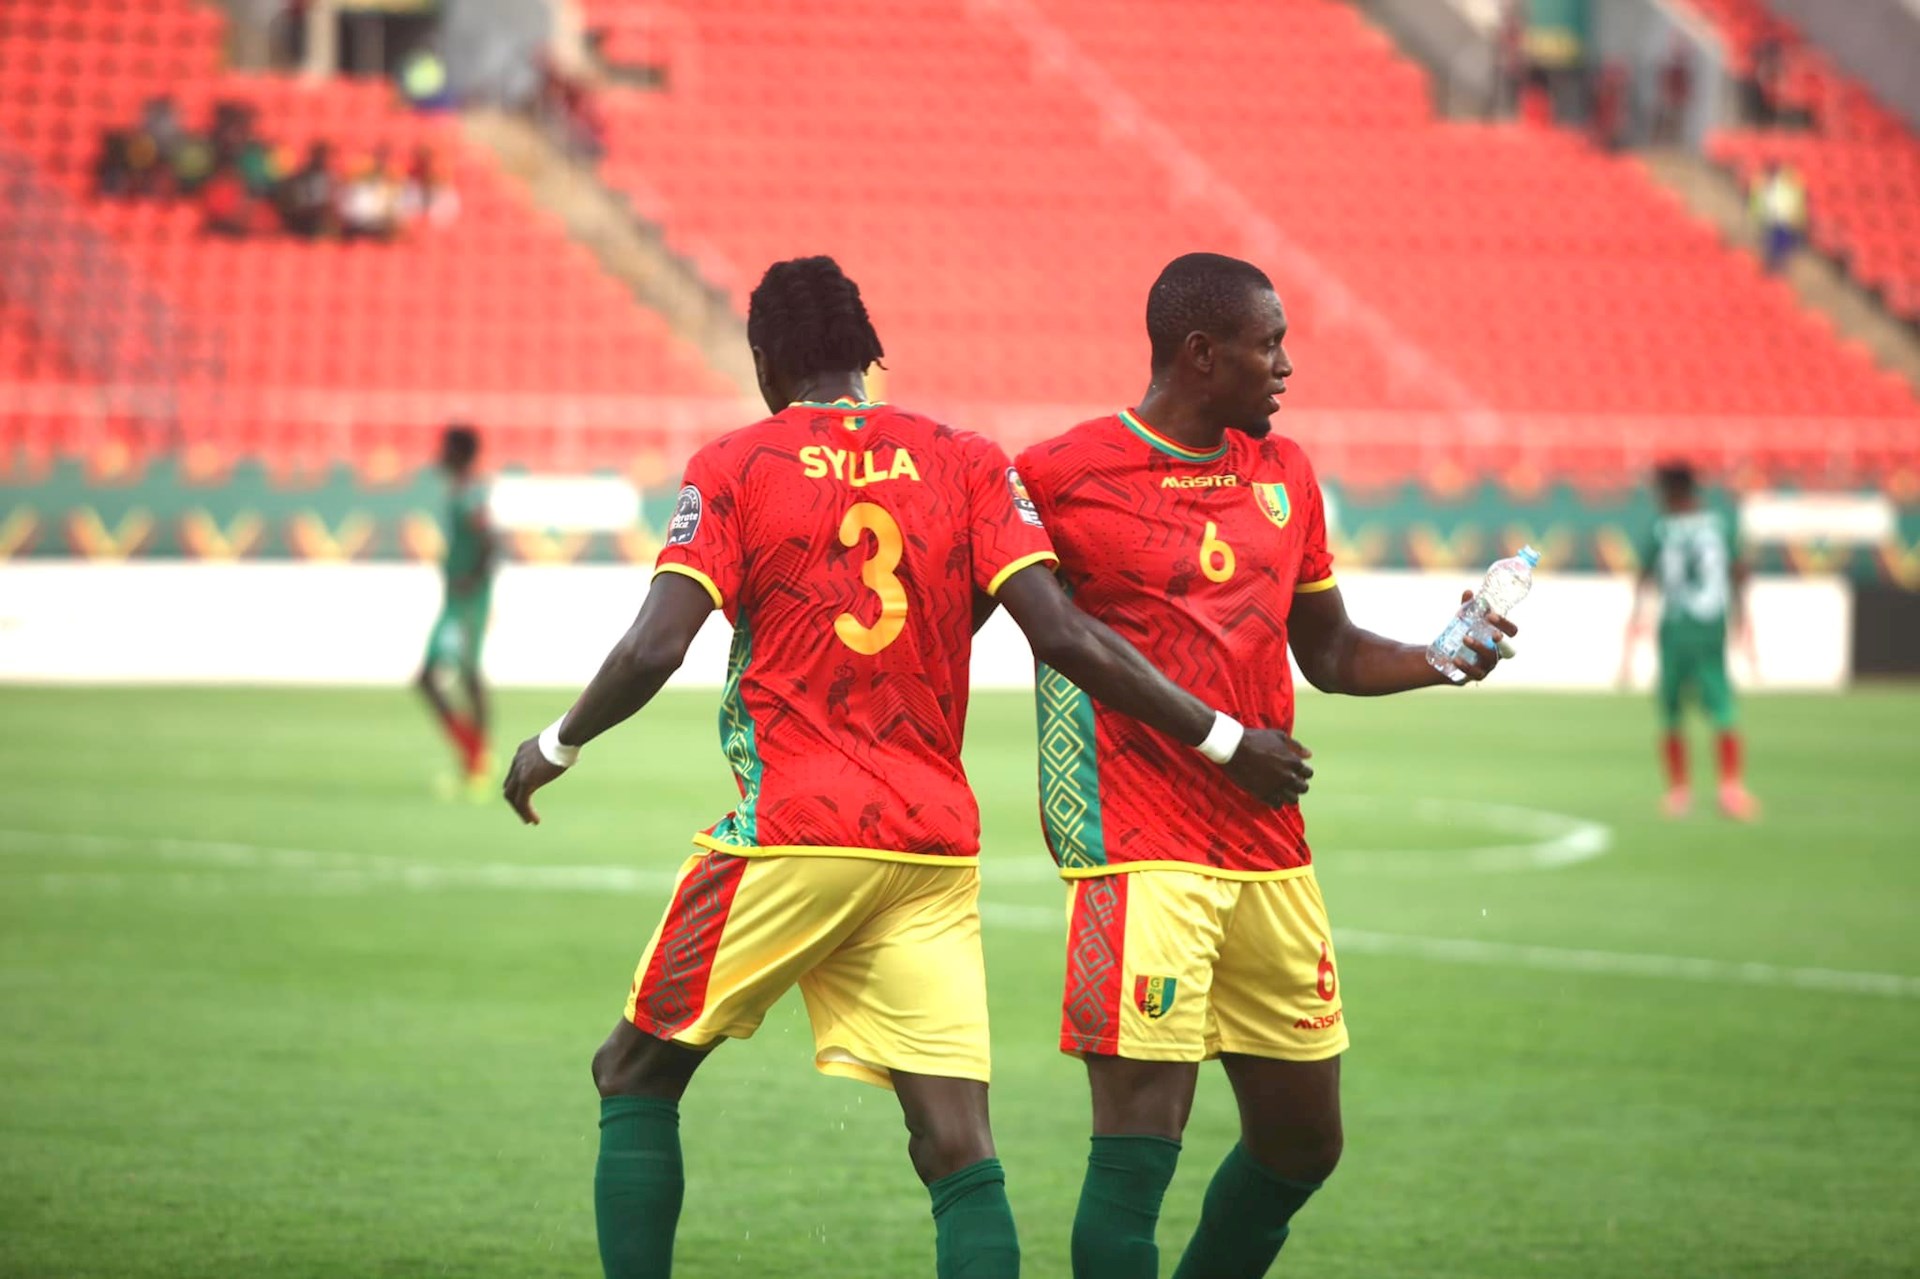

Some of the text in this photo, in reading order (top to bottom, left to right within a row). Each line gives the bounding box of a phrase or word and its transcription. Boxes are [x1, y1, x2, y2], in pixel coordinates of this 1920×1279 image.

[799, 445, 921, 487] SYLLA
[834, 502, 907, 655] 3
[1200, 521, 1235, 583] 6
[1317, 941, 1335, 1001] 6
